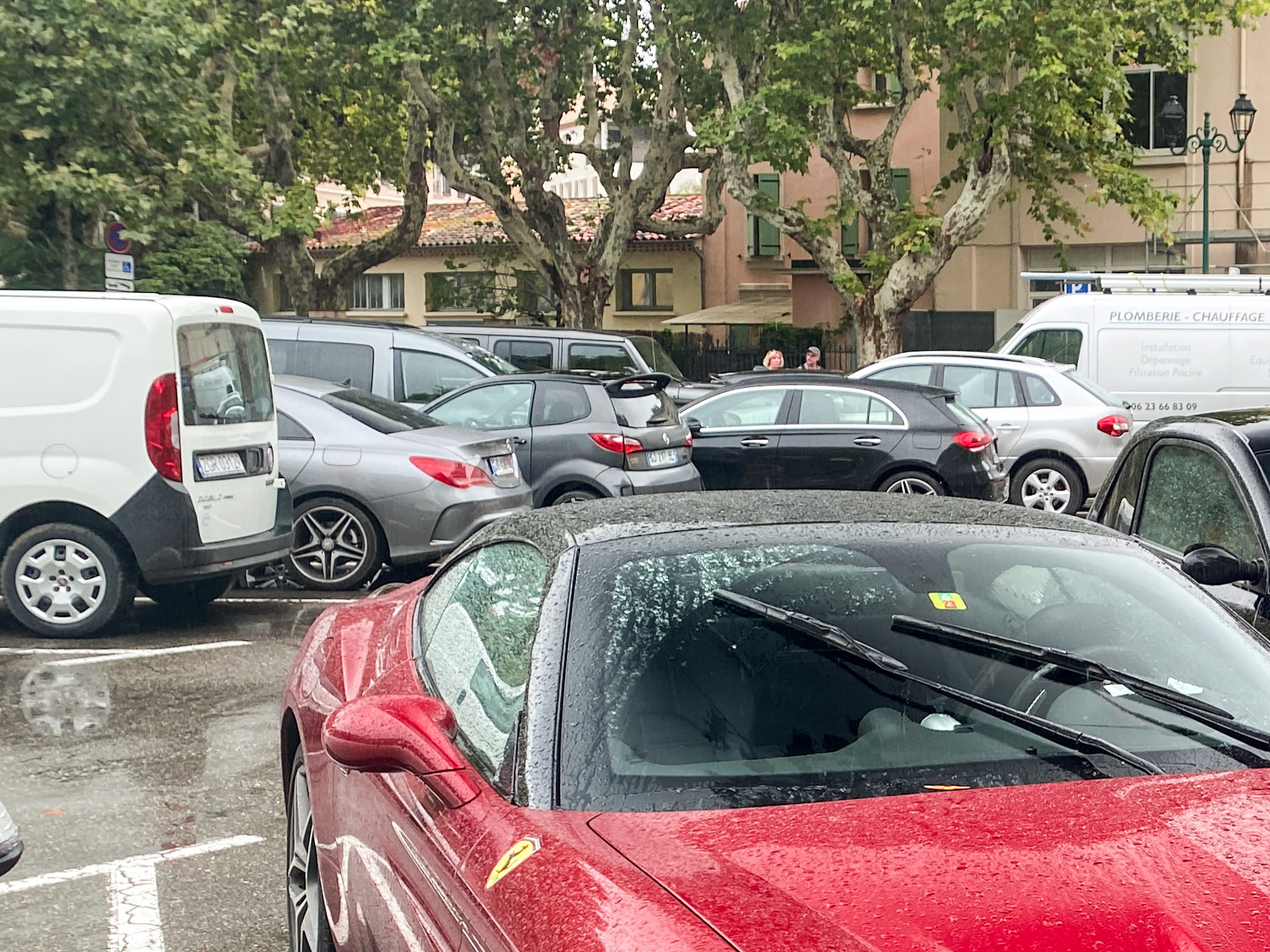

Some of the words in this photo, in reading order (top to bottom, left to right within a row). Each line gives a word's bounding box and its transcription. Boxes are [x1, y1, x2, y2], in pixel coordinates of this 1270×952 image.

[1109, 311, 1182, 322] PLOMBERIE
[1193, 311, 1265, 322] CHAUFFAGE
[1141, 342, 1191, 352] Installation
[1140, 354, 1191, 367] Dépannage
[1129, 368, 1169, 377] Filtration
[1172, 368, 1203, 377] Piscine
[1131, 402, 1142, 410] 06
[1145, 402, 1155, 410] 23
[1158, 402, 1169, 410] 66
[1172, 402, 1183, 410] 83
[1186, 402, 1197, 410] 09
